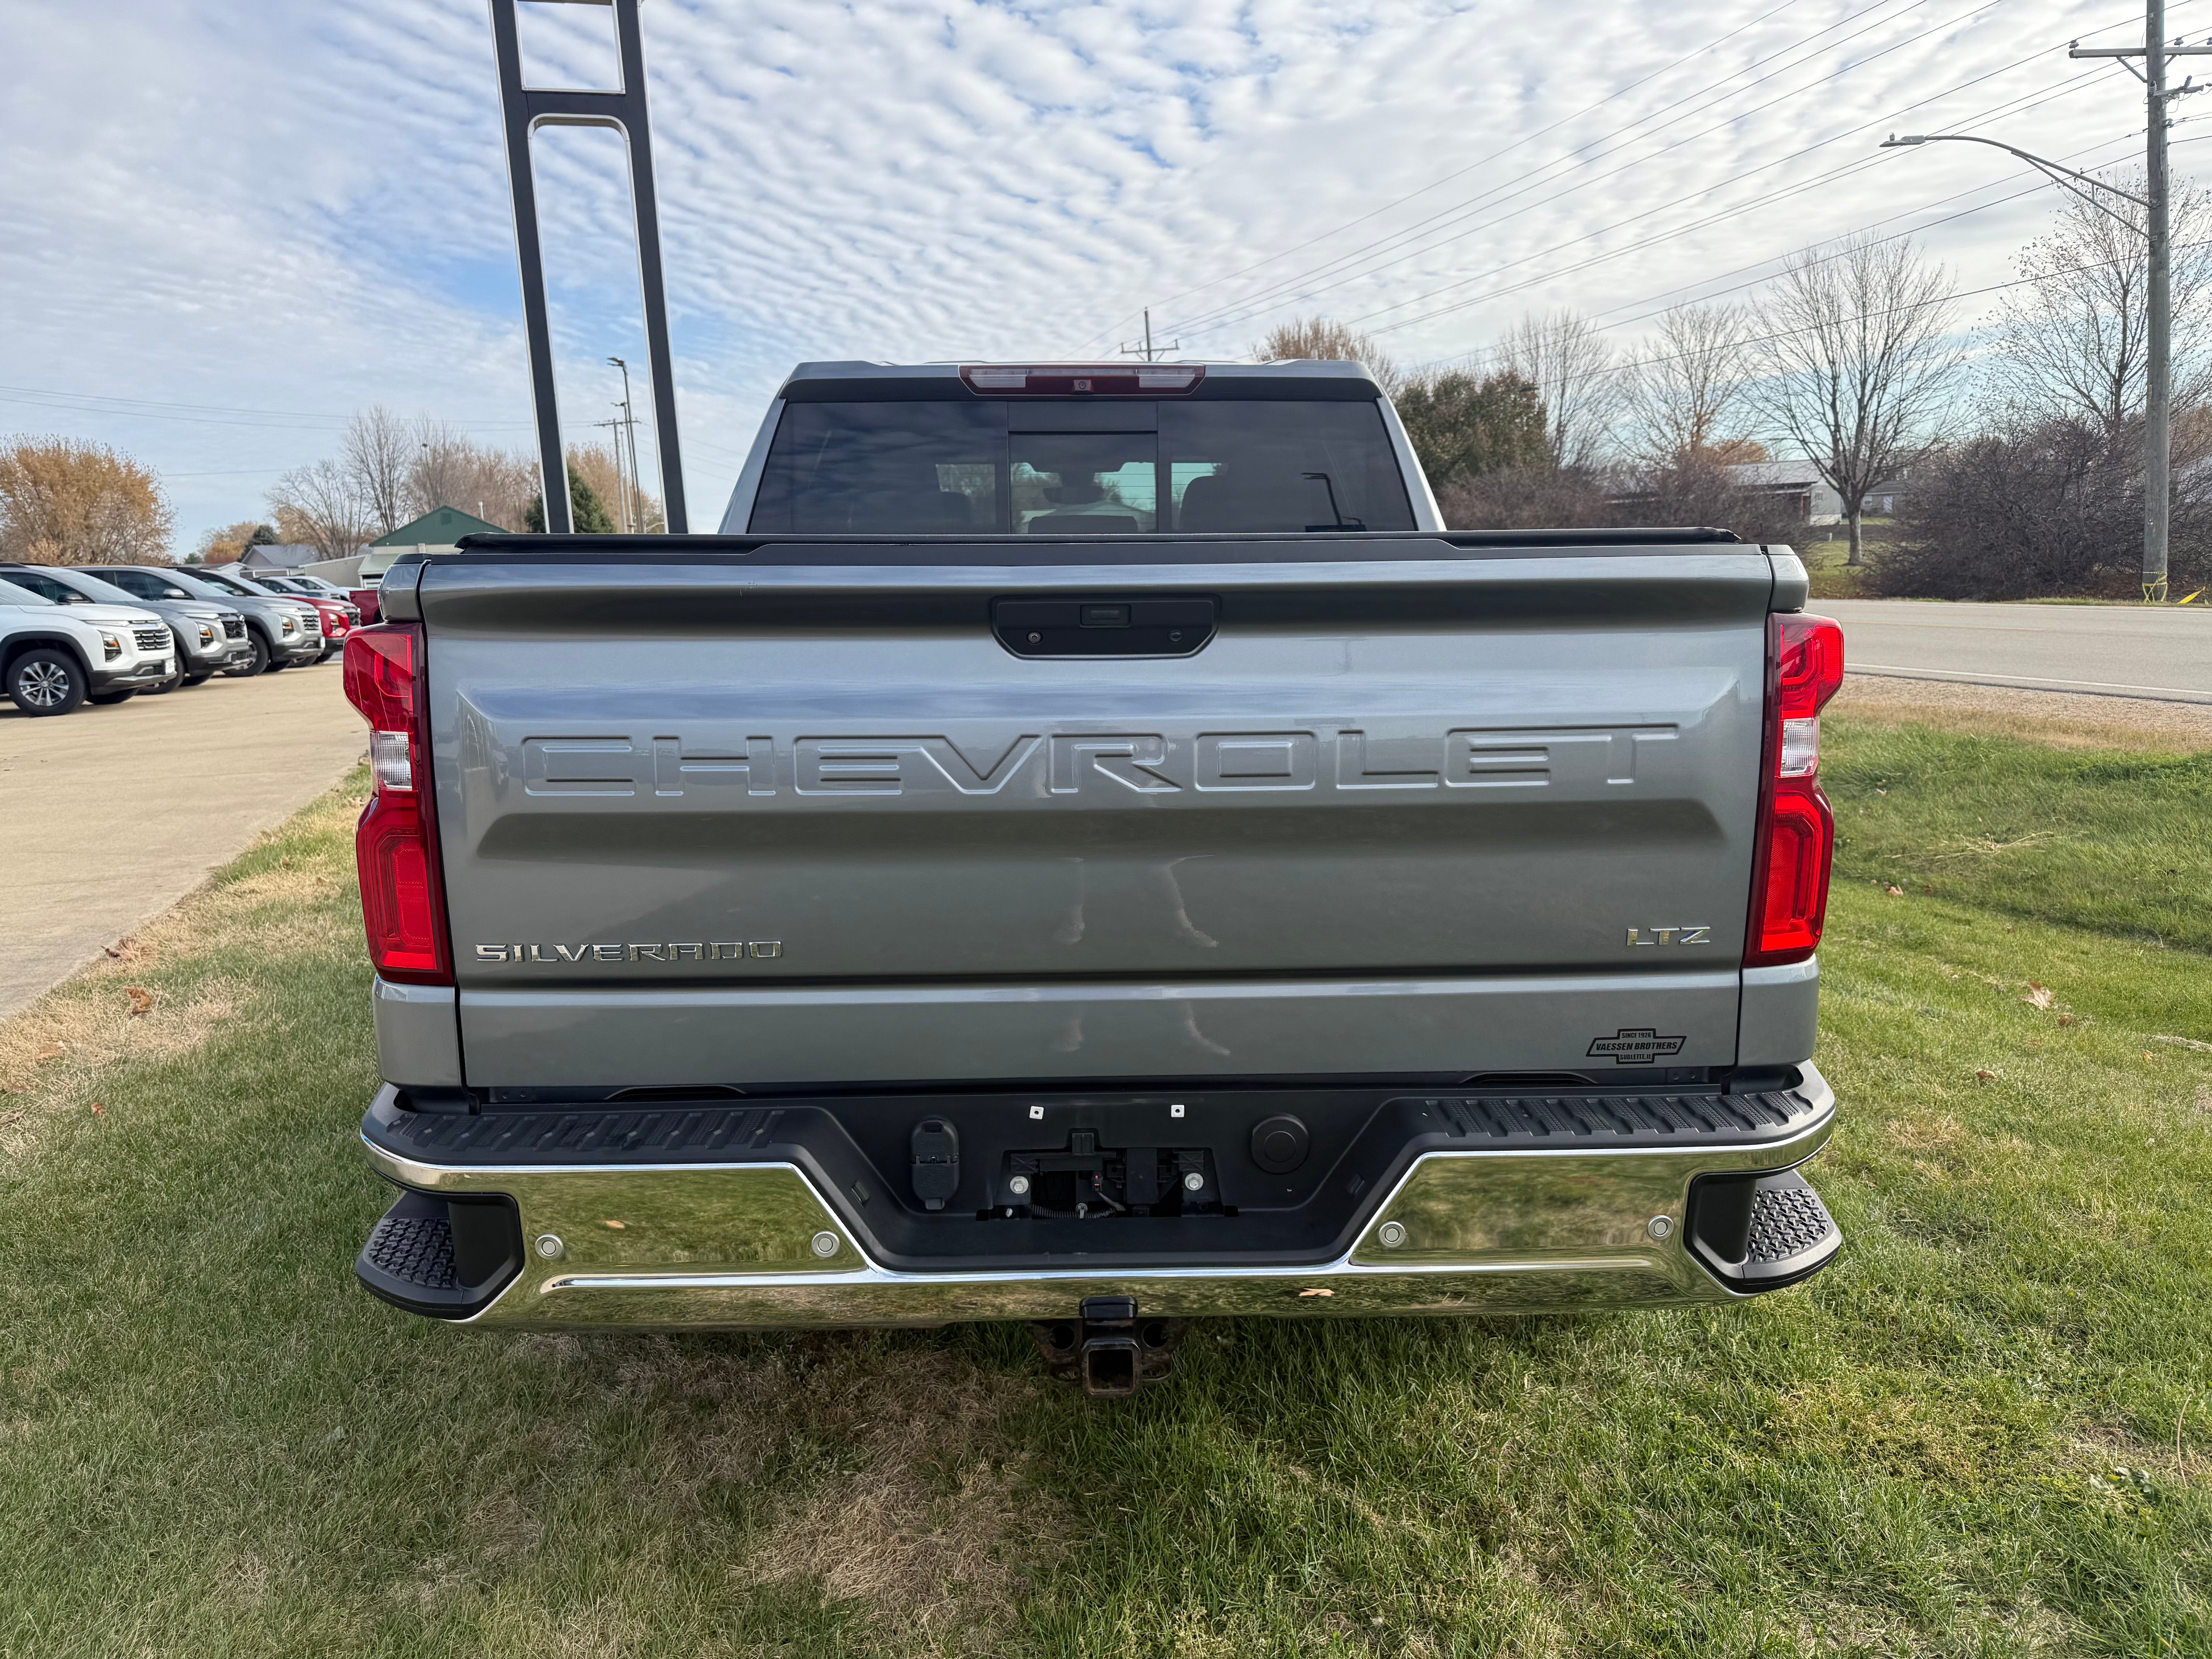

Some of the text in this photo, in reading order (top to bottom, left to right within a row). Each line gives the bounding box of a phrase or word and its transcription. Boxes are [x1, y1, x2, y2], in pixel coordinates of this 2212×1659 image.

[521, 723, 1681, 795] CHEVROLET
[1626, 926, 1711, 946] LTZ
[476, 939, 783, 963] SILVERADO
[1596, 1042, 1677, 1051] VAESSEN BROTHERS
